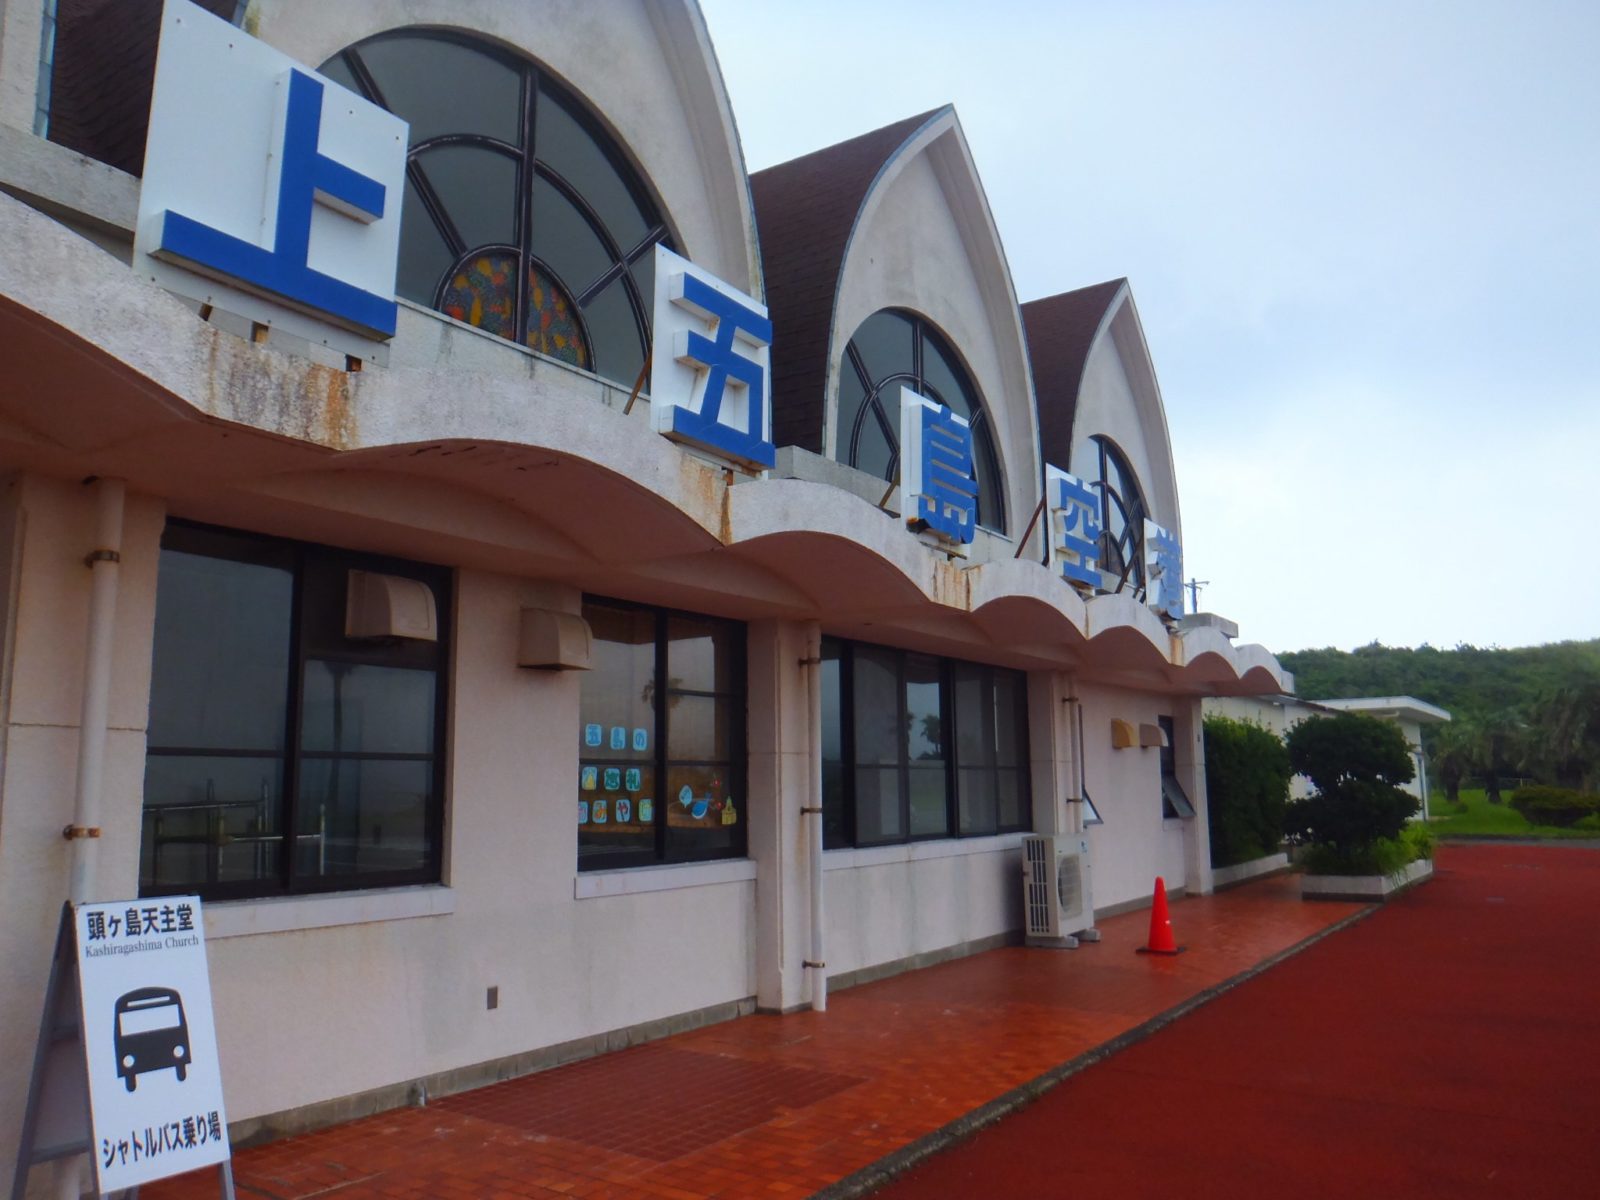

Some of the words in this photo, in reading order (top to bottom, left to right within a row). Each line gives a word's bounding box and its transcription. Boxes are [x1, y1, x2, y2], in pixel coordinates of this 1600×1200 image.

[85, 941, 163, 958] Kashiragashima
[165, 935, 199, 949] Church
[103, 1110, 221, 1168] シャトルバス乗り場
